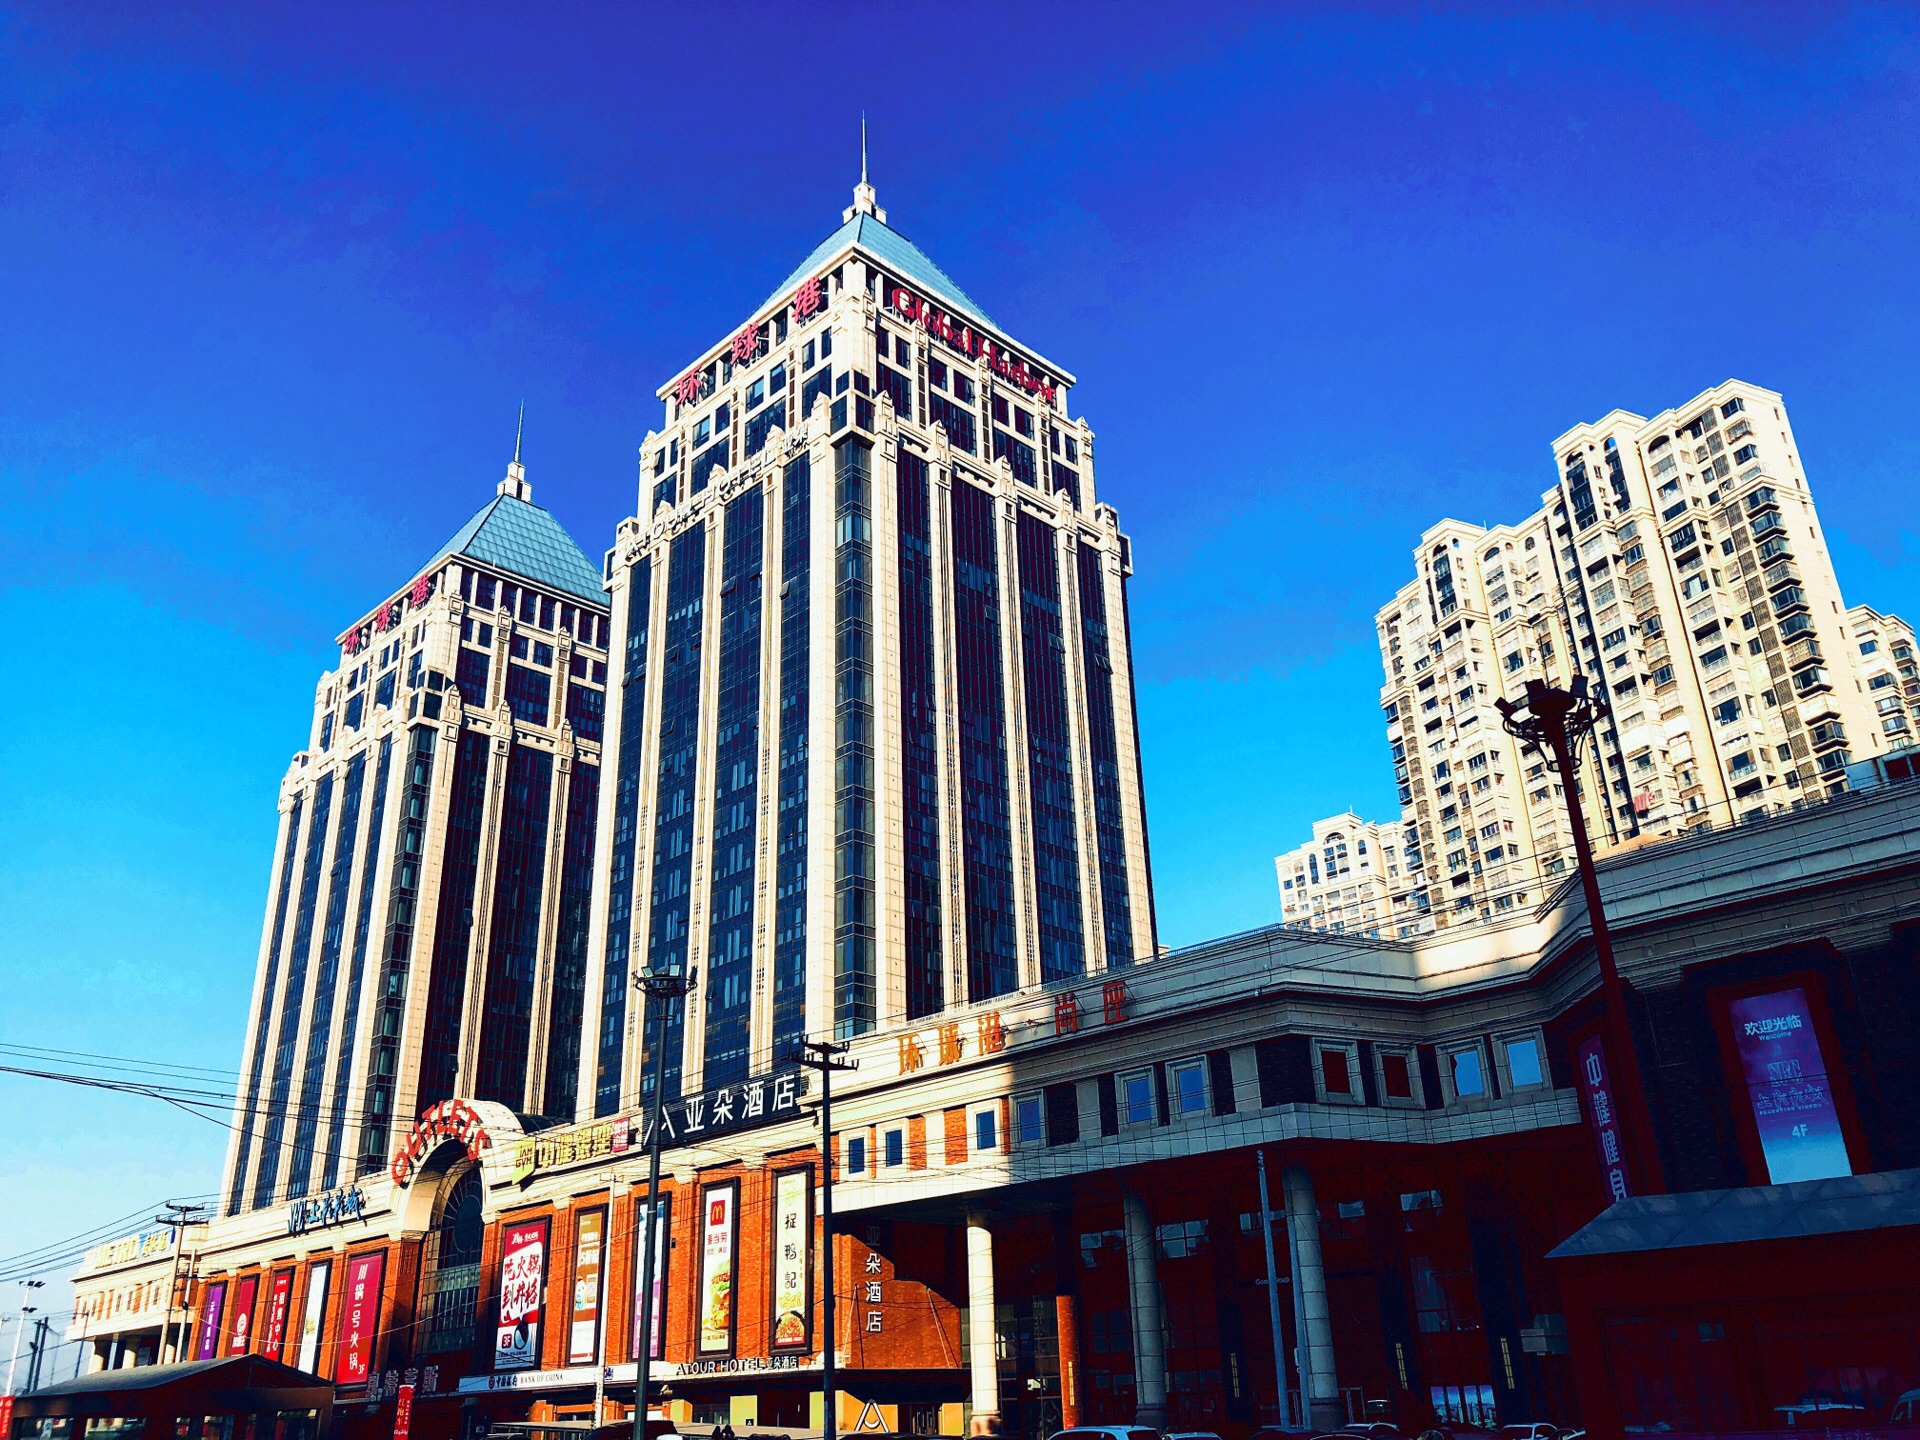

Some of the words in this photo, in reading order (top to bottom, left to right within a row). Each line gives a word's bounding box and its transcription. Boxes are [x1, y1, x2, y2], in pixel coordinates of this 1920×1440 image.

[675, 276, 822, 406] 环球港
[892, 287, 973, 355] Global
[975, 335, 1056, 403] Harbor
[1744, 1014, 1802, 1035] 欢迎光临
[1759, 1031, 1792, 1041] Welcome
[684, 1074, 796, 1133] 亚朵酒店
[1792, 1124, 1808, 1137] 4F
[391, 1099, 488, 1184] OUTLETS
[707, 1232, 727, 1245] 麦当劳
[504, 1254, 541, 1281] 吃火锅
[865, 1226, 882, 1333] 亚朵酒店
[502, 1277, 538, 1312] 到井格
[503, 1335, 511, 1347] 3F
[358, 1364, 366, 1374] 3F
[677, 1361, 716, 1375] ATOUR
[721, 1358, 766, 1372] HOTEL
[767, 1356, 798, 1369] 亚朵酒店
[496, 1374, 518, 1387] 中国银行
[520, 1375, 535, 1384] BANK
[546, 1373, 563, 1381] CHINA
